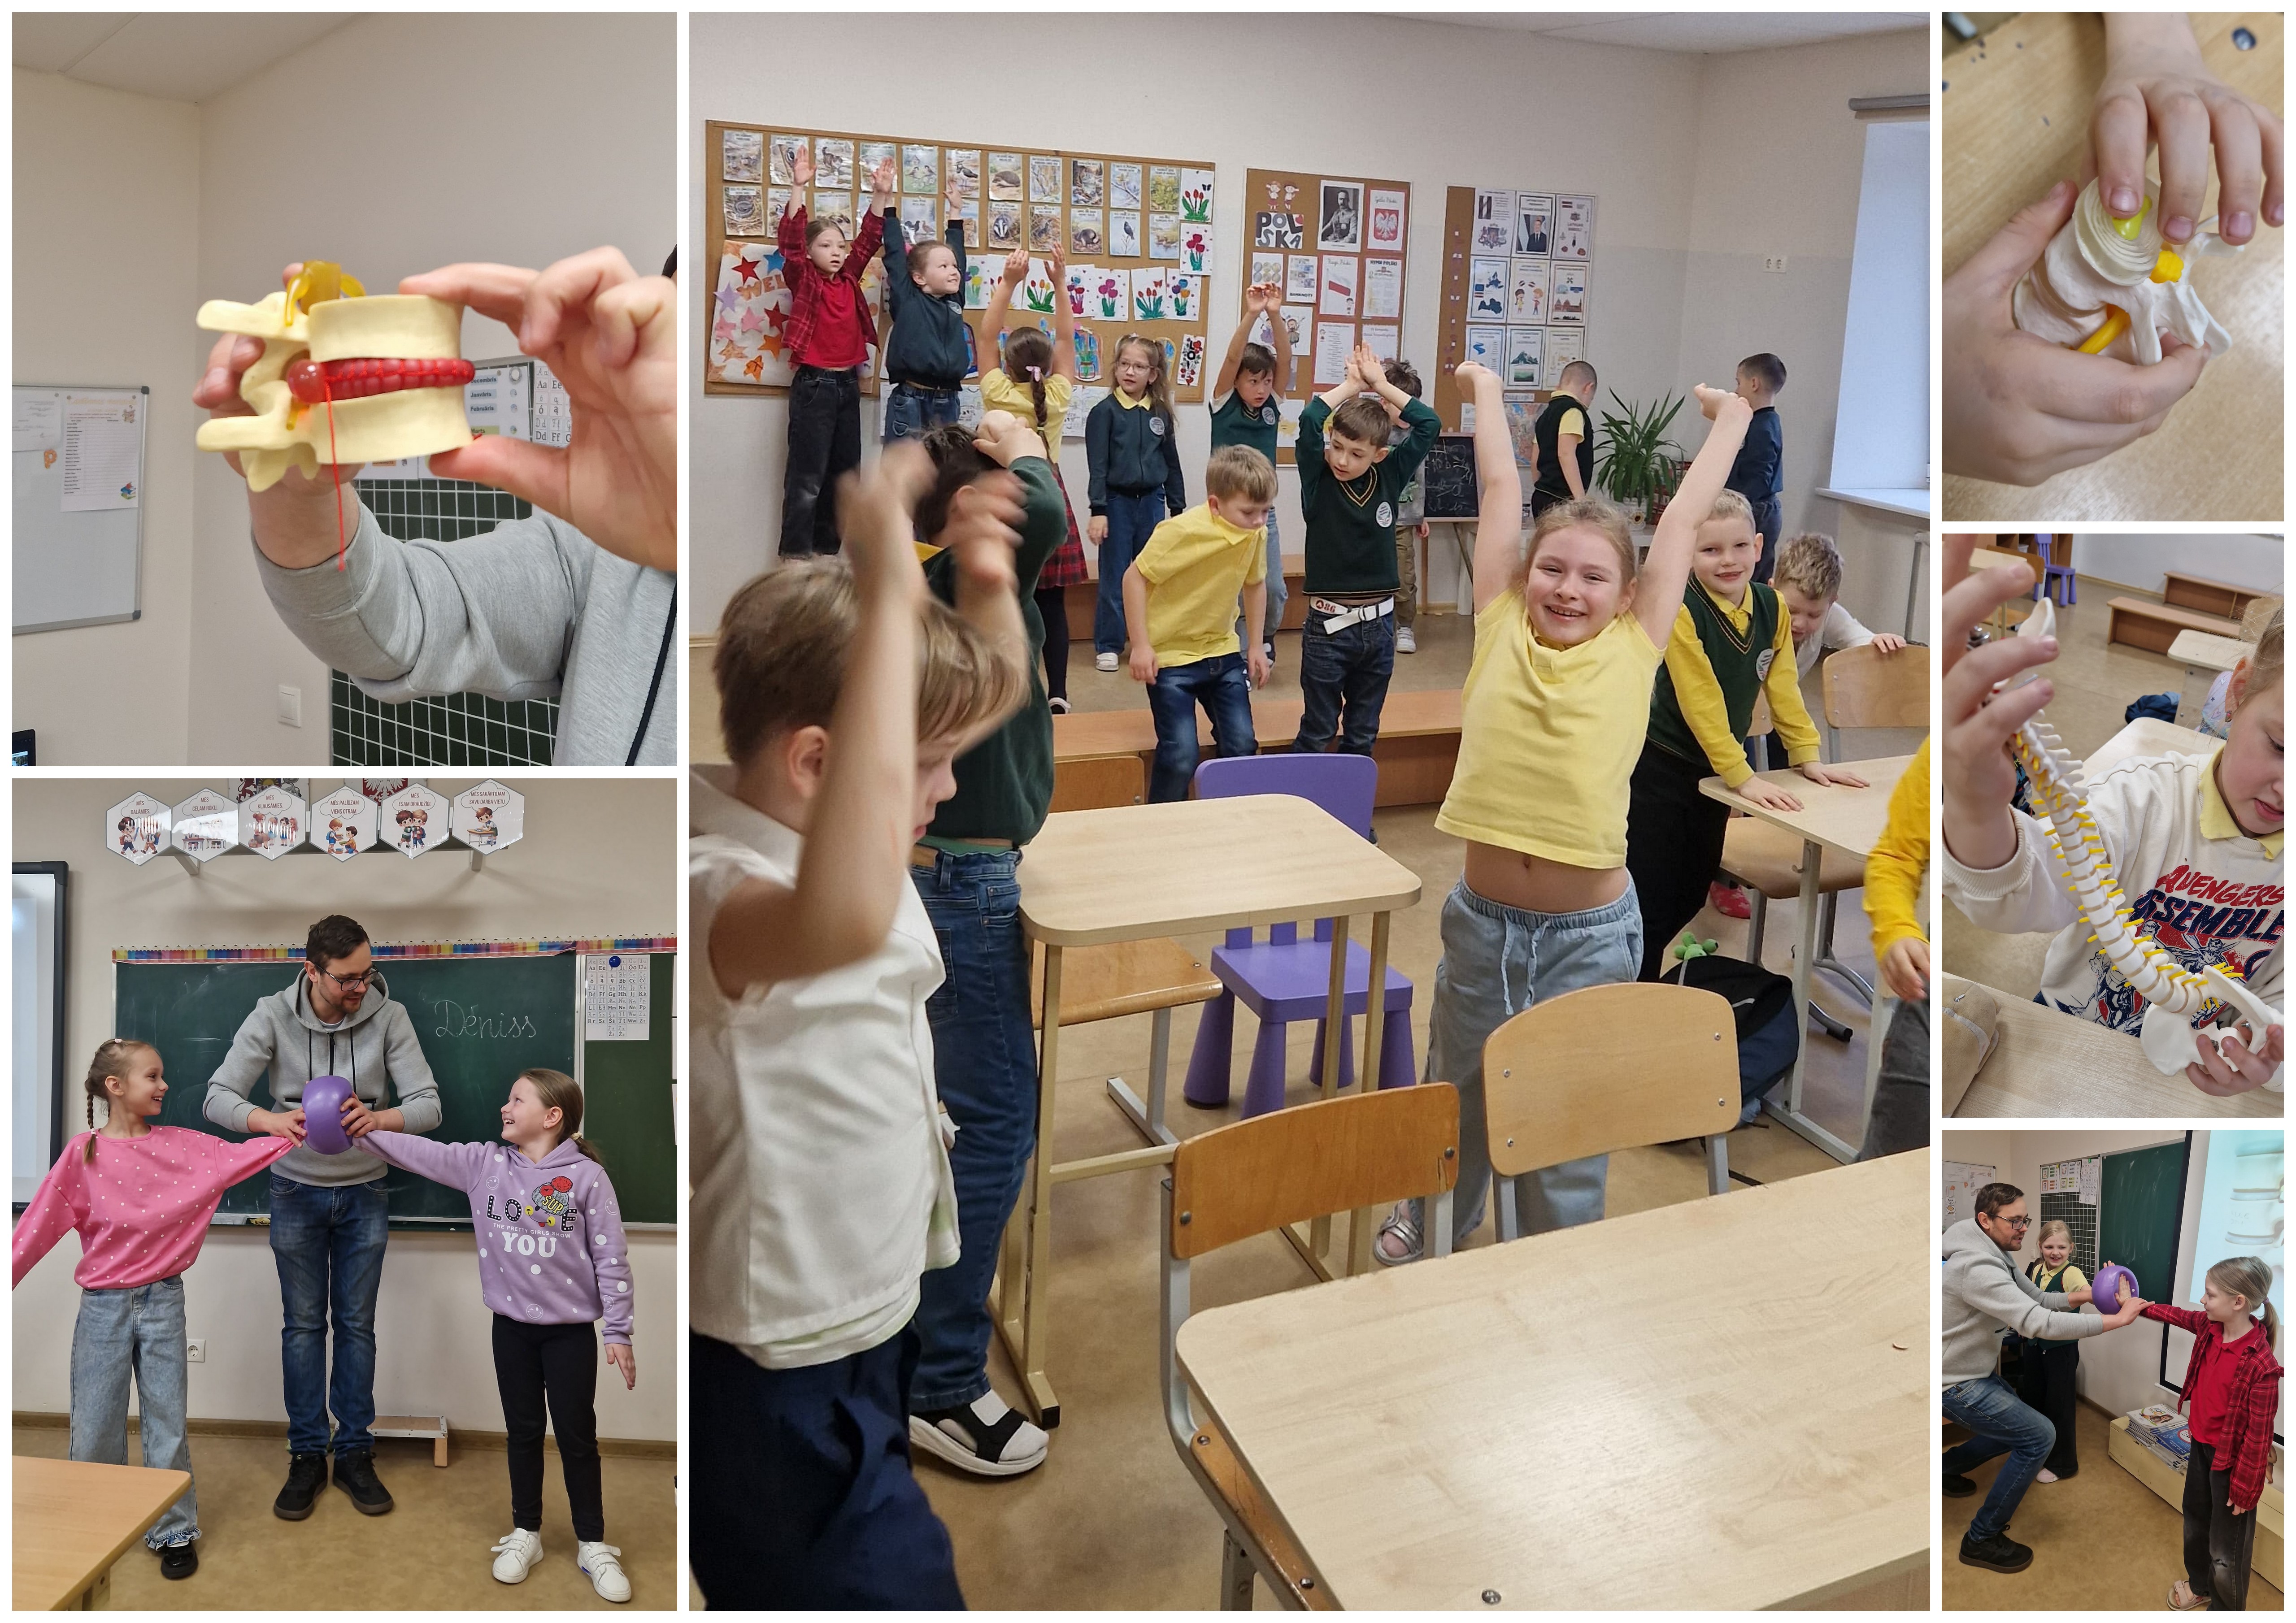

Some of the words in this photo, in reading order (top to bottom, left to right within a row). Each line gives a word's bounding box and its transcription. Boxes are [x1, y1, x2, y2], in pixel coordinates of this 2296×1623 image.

[2154, 864, 2284, 908] AVENGERS
[542, 1195, 564, 1214] SUP
[507, 1225, 528, 1233] PRETTY
[501, 1231, 557, 1258] YOU
